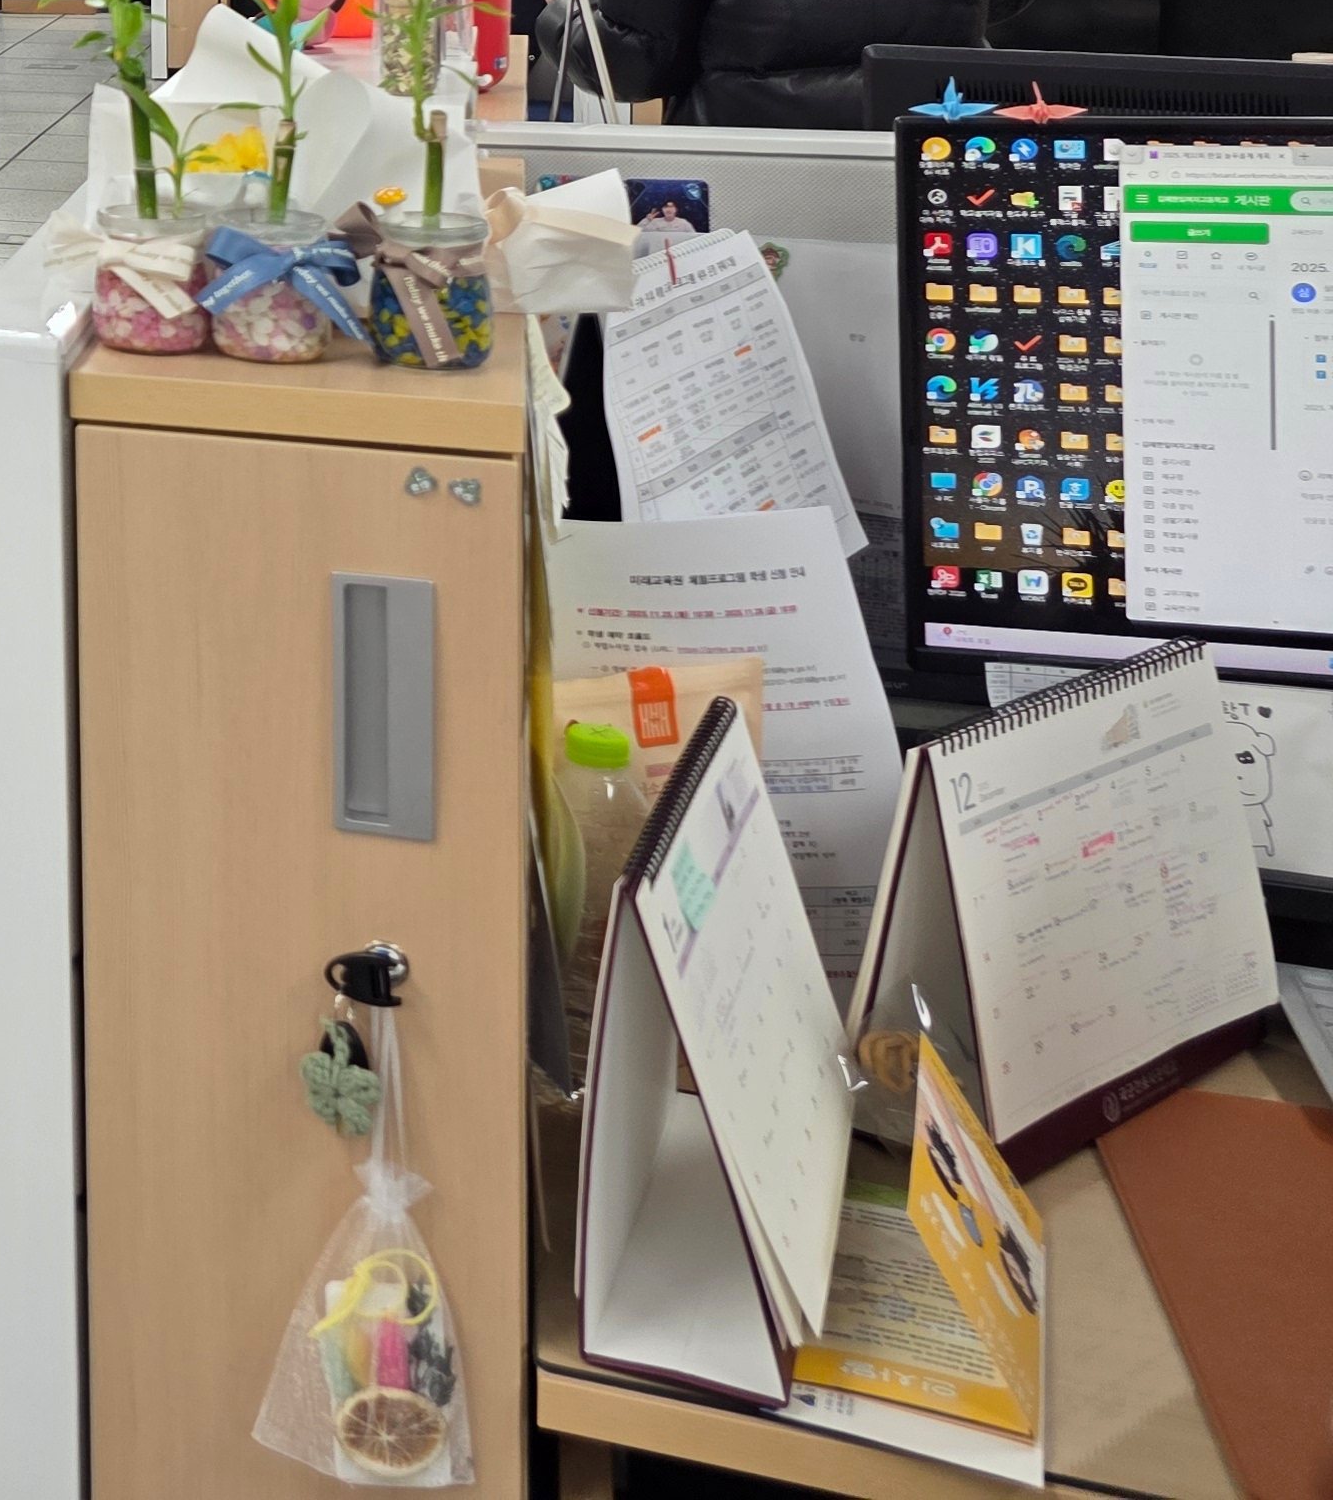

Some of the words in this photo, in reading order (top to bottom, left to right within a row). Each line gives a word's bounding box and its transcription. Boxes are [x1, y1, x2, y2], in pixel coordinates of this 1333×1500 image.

[1234, 195, 1271, 207] 게시판
[1291, 262, 1330, 273] 2025.
[417, 306, 430, 322] we
[950, 772, 977, 814] 12
